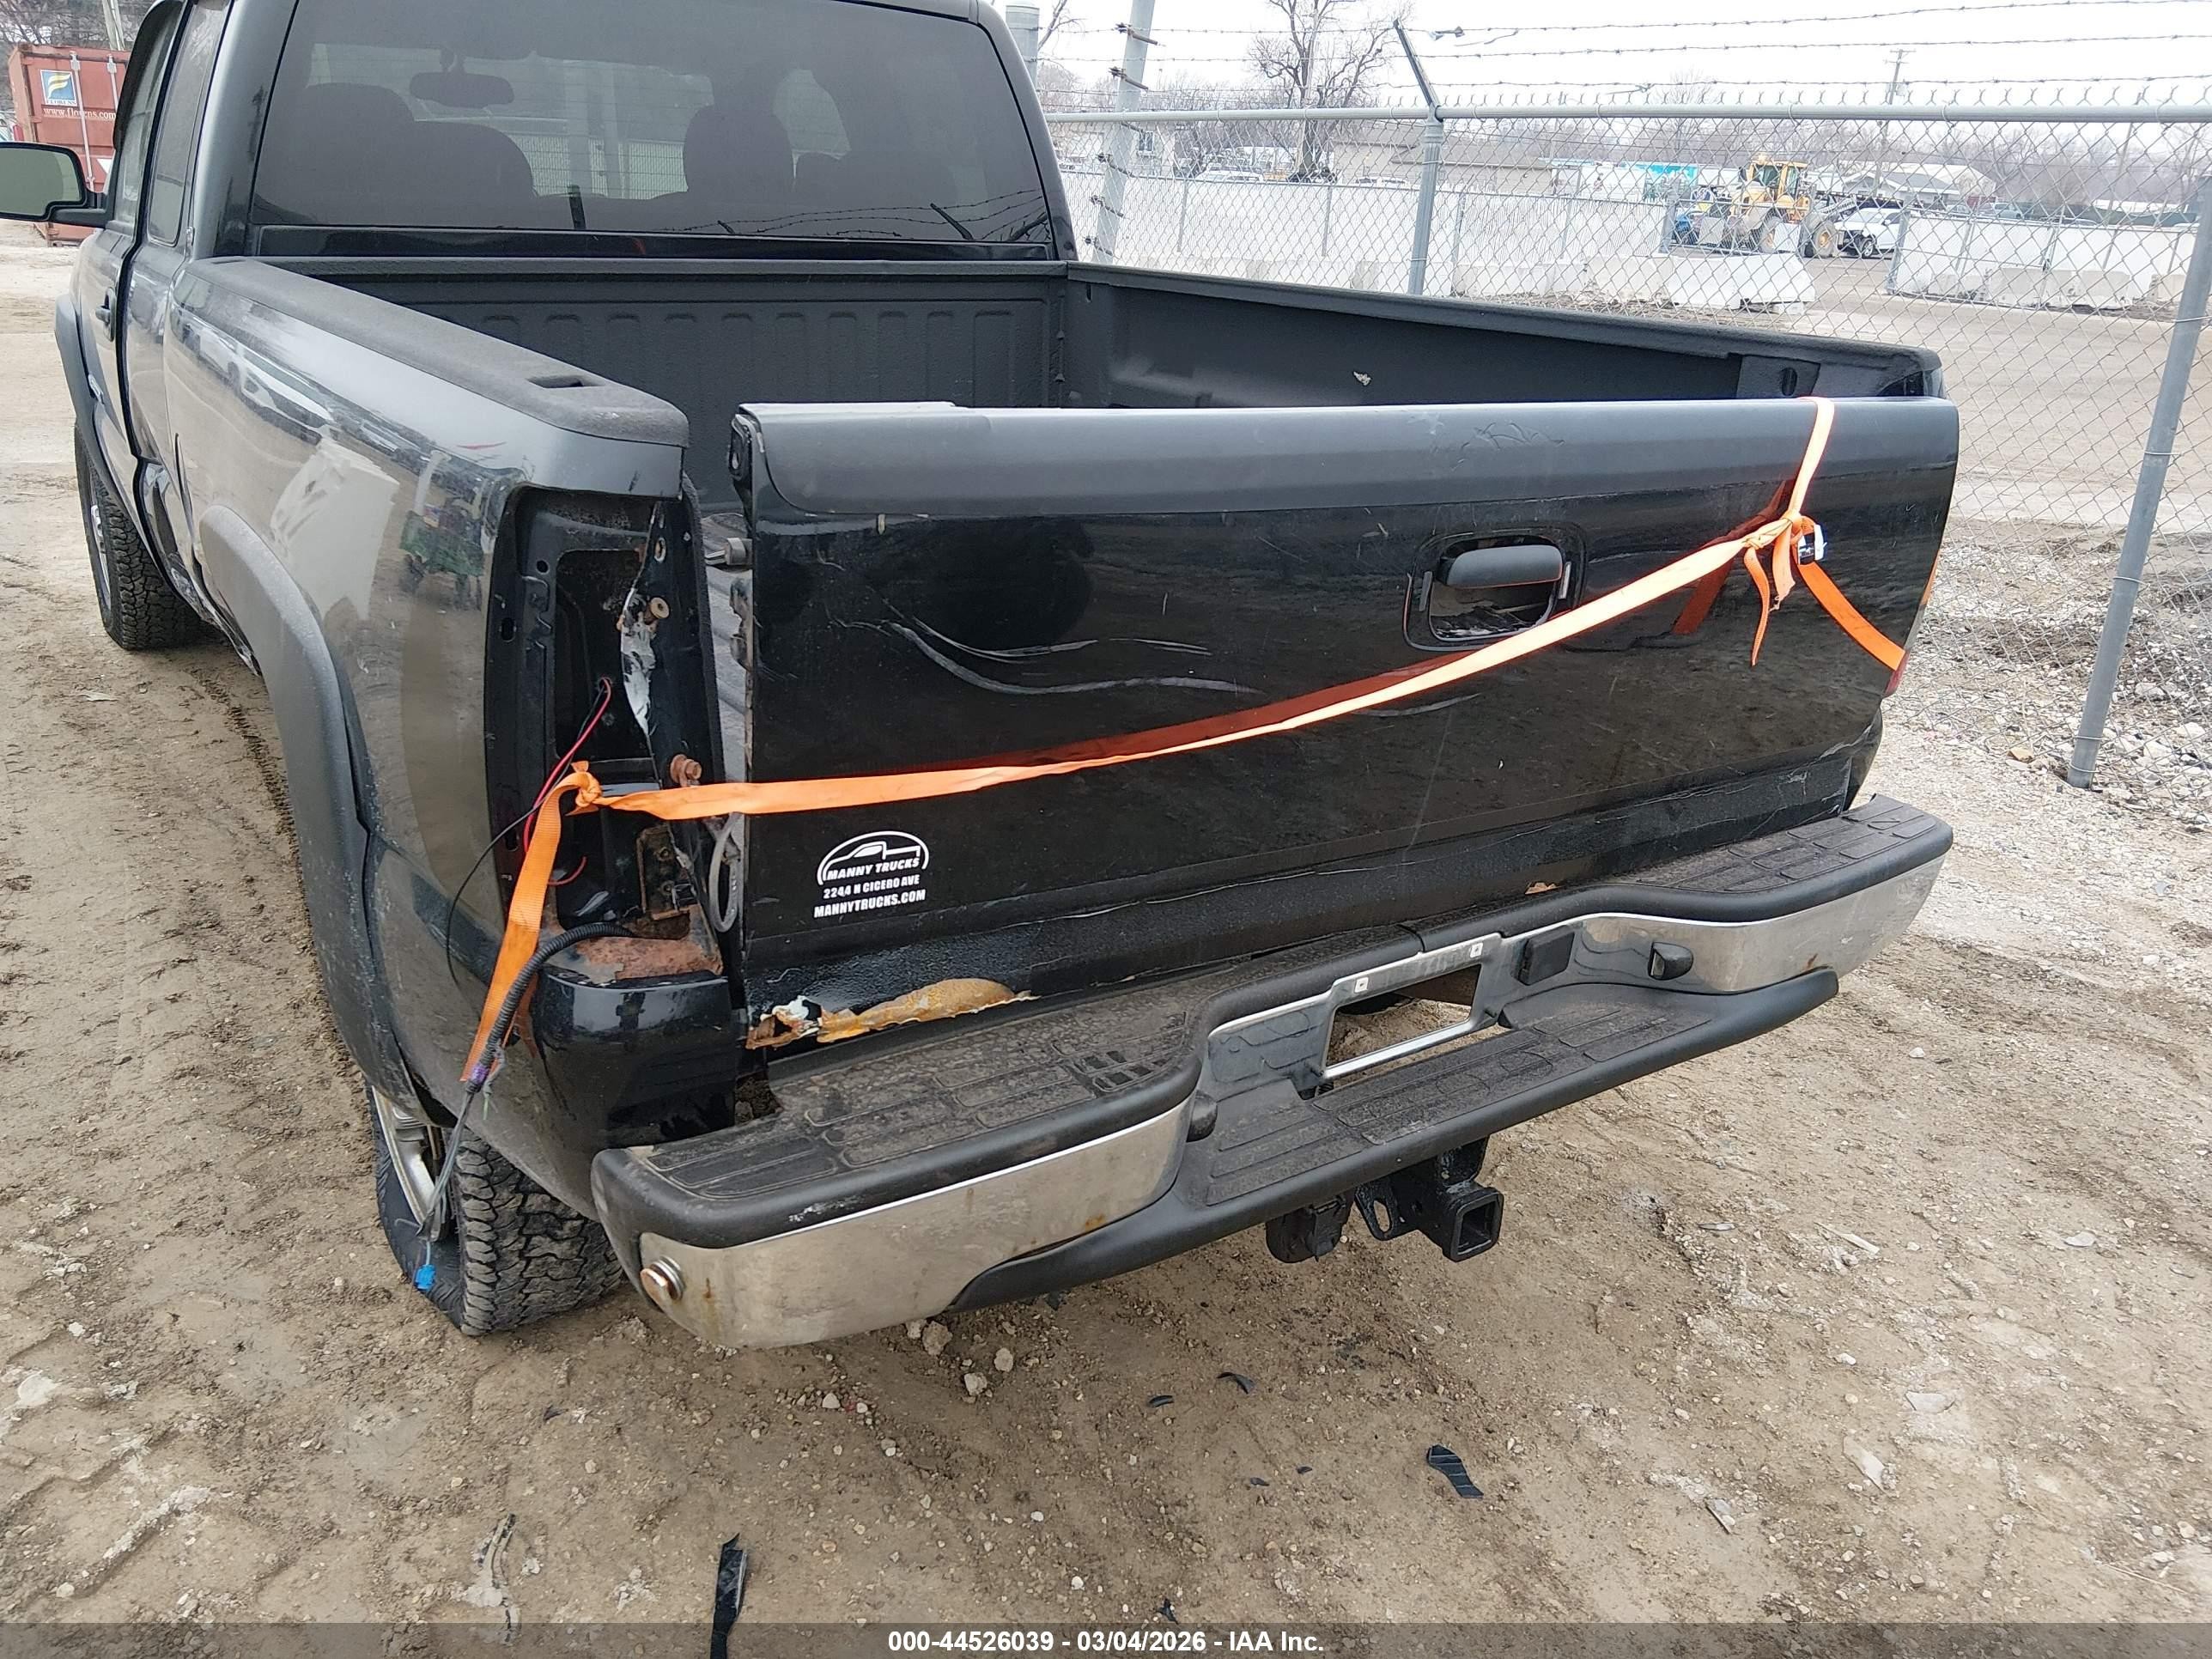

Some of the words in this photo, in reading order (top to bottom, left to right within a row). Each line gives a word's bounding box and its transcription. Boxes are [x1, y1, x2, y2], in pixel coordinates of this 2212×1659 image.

[43, 107, 116, 119] www.flons.com
[827, 865, 873, 881] MANNY
[875, 857, 920, 873] TRUCKS
[823, 885, 852, 900] 2244
[854, 884, 861, 895] N
[862, 878, 900, 893] CICERO
[901, 874, 920, 887] AVE
[813, 889, 927, 919] MANNYTRUCKS.COM
